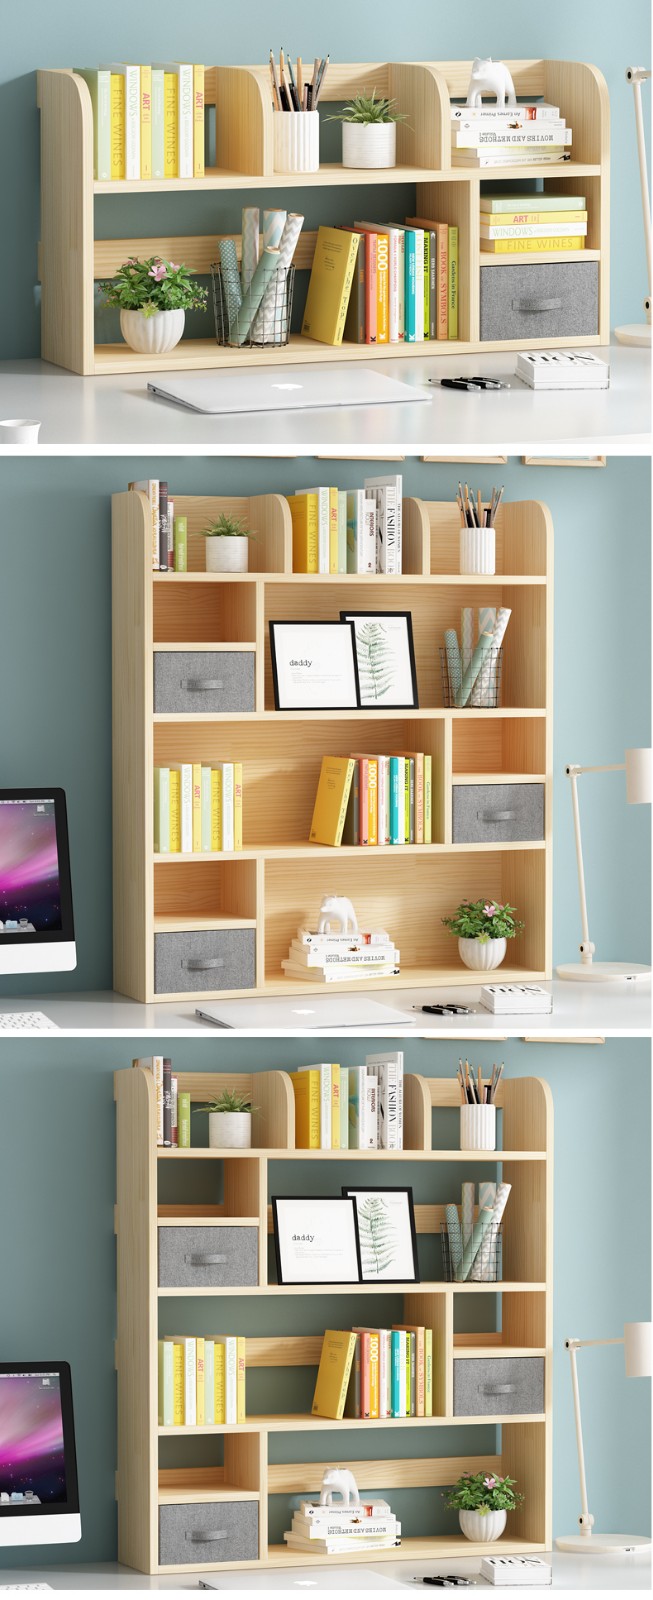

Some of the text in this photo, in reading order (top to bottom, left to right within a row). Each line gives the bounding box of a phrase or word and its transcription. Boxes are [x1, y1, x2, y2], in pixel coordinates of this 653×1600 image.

[129, 70, 138, 118] WINDOWS
[182, 69, 191, 116] WINDOWS
[112, 89, 122, 166] FINE WINES
[166, 88, 176, 165] FINE WINES
[492, 226, 533, 236] WINDOWS
[513, 215, 528, 223] ART
[378, 238, 388, 270] 1000
[507, 238, 573, 250] FINE WINES
[387, 489, 395, 507] THE
[387, 508, 395, 546] FASHION
[370, 1337, 378, 1362] 1000
